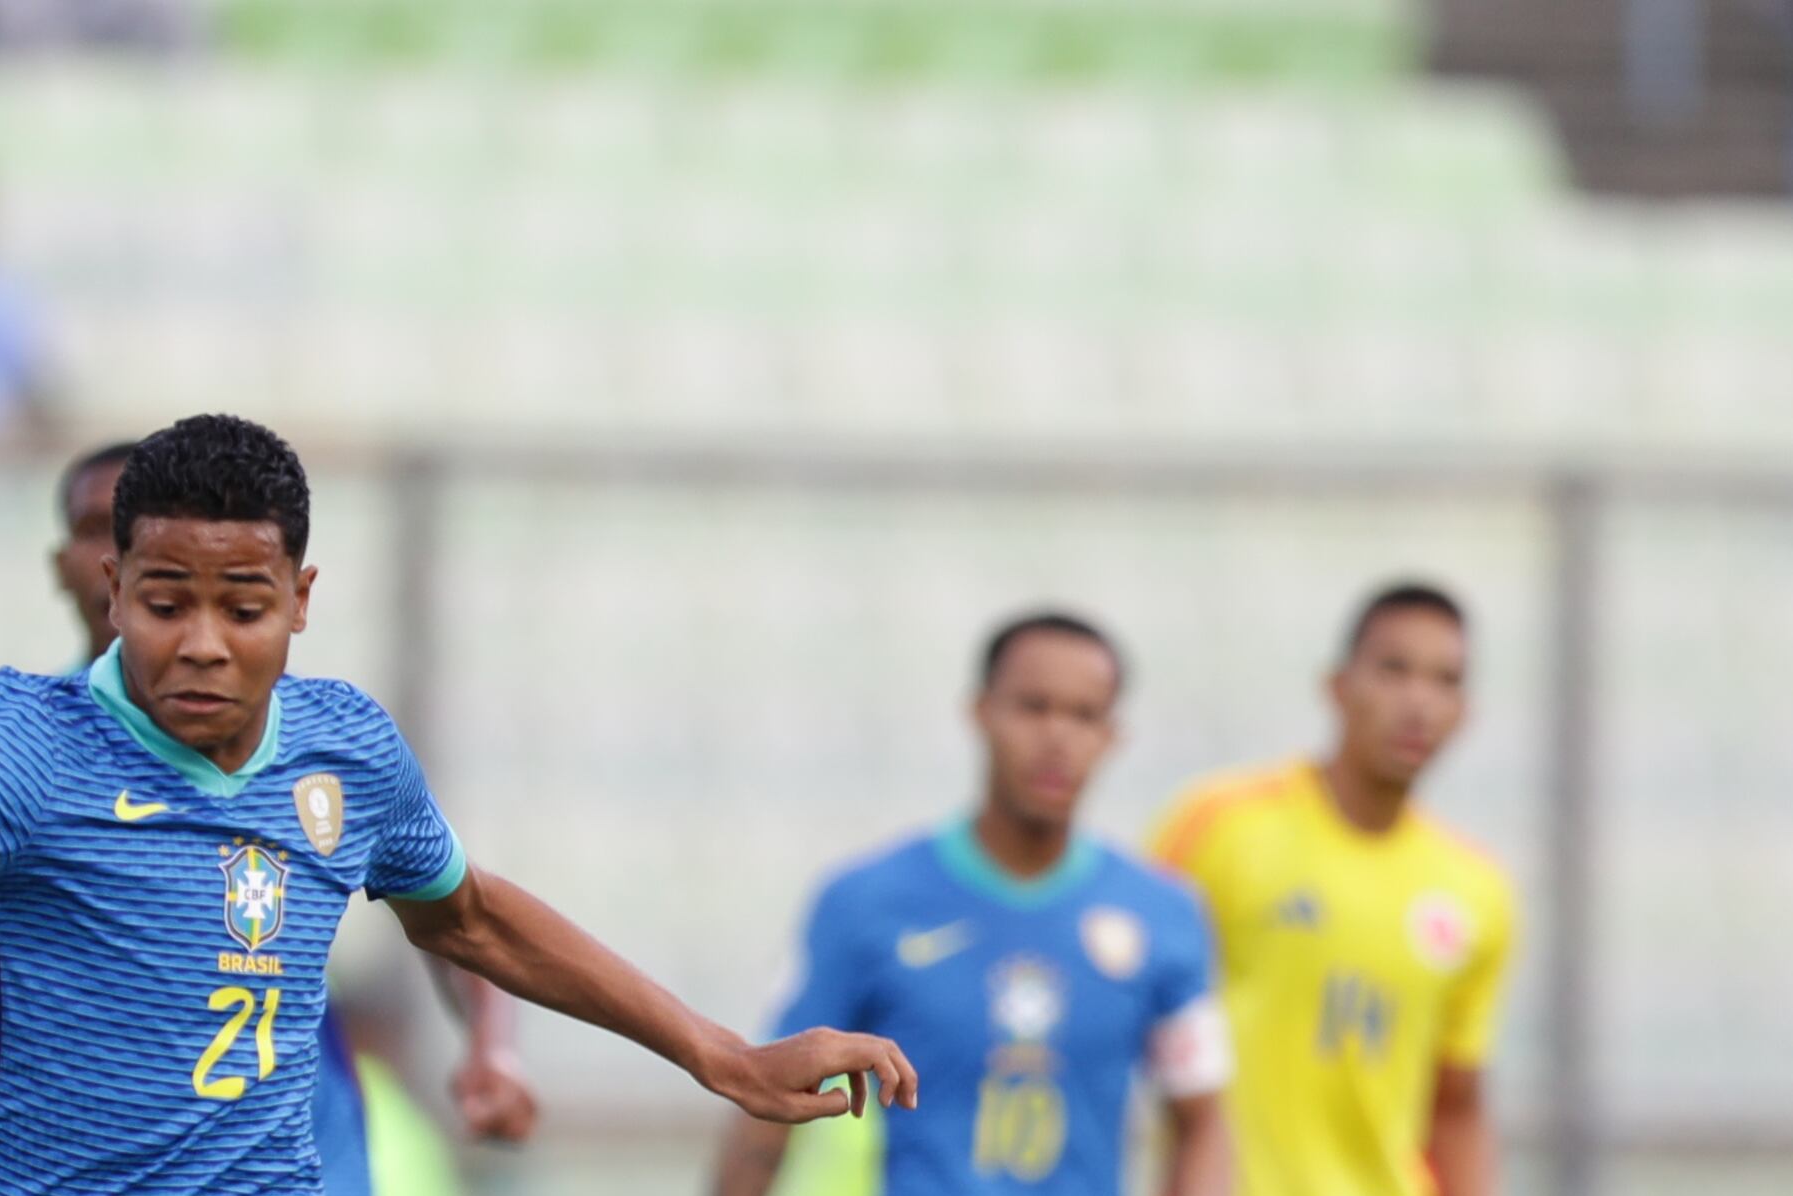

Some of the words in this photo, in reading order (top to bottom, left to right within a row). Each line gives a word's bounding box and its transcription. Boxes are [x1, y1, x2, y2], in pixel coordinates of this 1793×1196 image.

[243, 888, 267, 900] CBF
[217, 952, 284, 976] BRASIL
[192, 986, 281, 1099] 21
[973, 1074, 1068, 1182] 10
